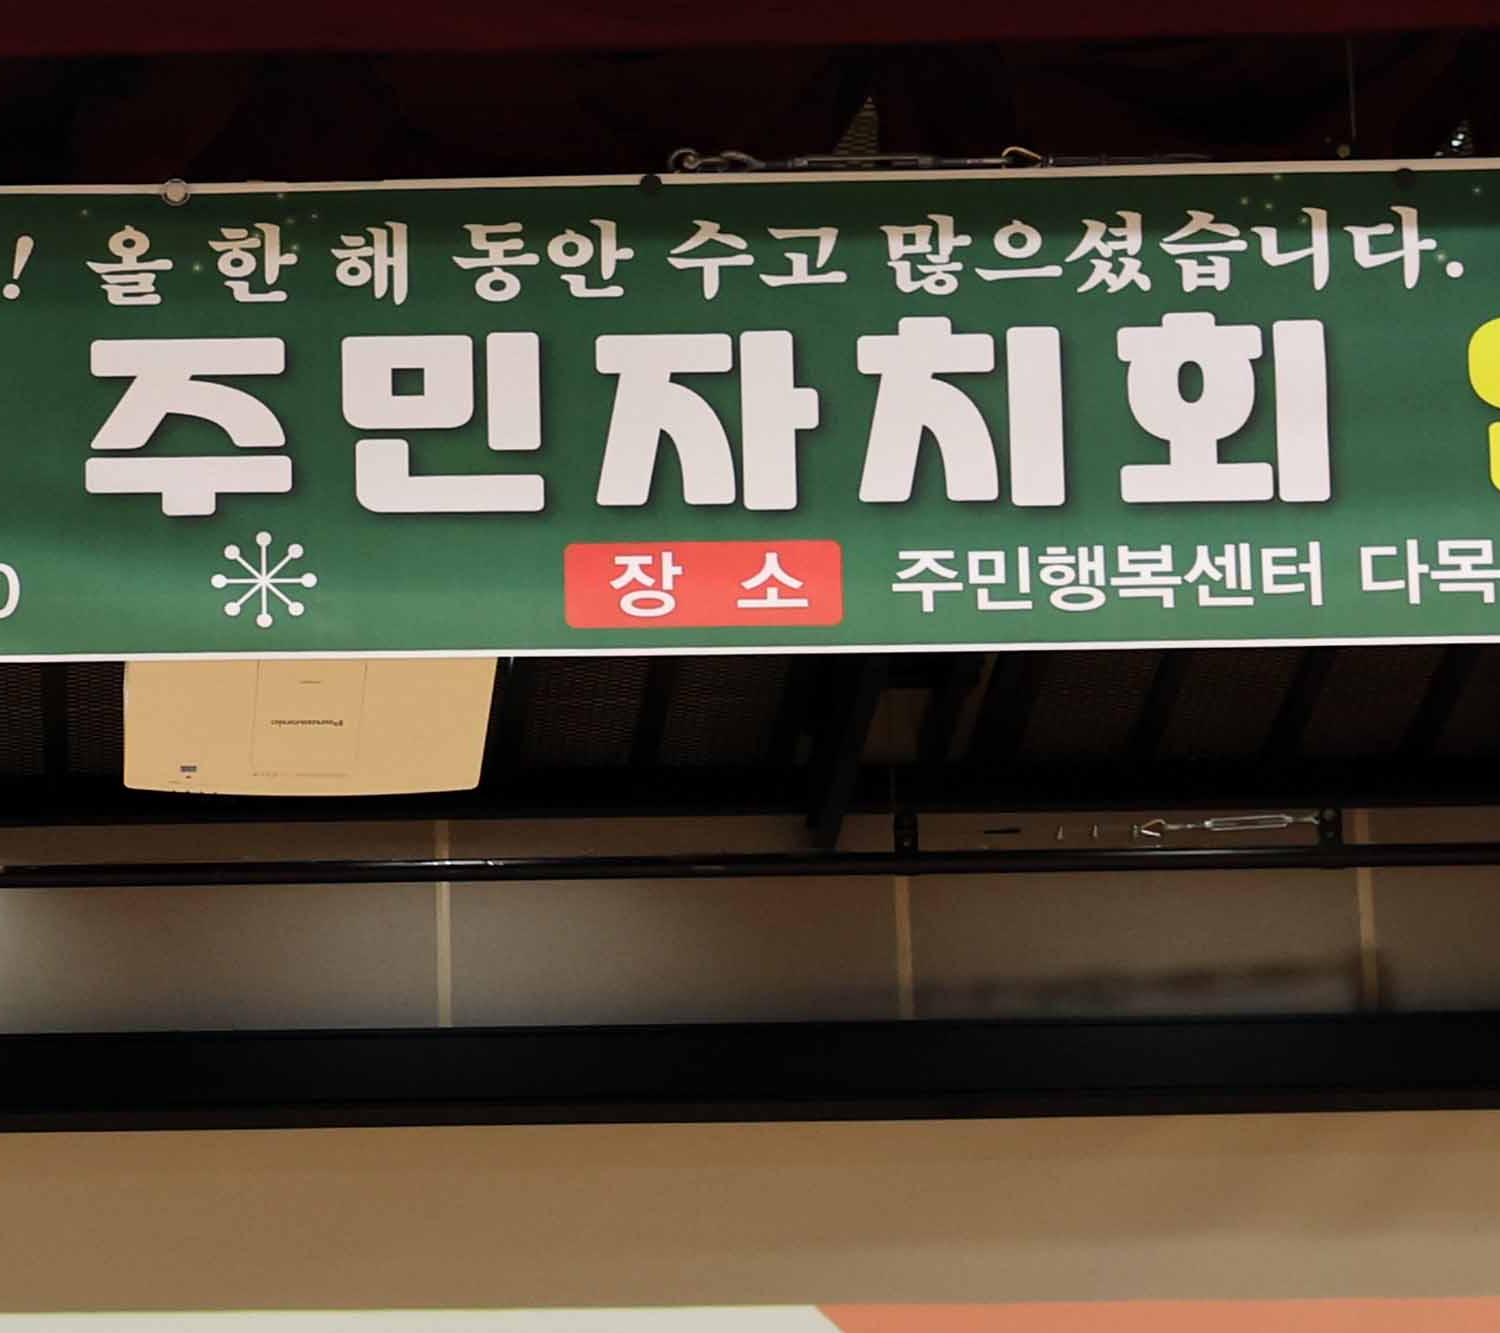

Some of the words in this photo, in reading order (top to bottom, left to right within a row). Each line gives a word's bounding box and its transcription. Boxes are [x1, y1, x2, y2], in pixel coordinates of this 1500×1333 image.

[87, 226, 172, 304] 올
[209, 224, 297, 301] 한
[332, 223, 407, 304] 해
[453, 220, 633, 301] 동안
[668, 221, 847, 299] 수고
[882, 207, 1463, 294] 많으셨습니다.
[86, 312, 1330, 515] 주민자치회
[892, 541, 1323, 612] 주민행복센터
